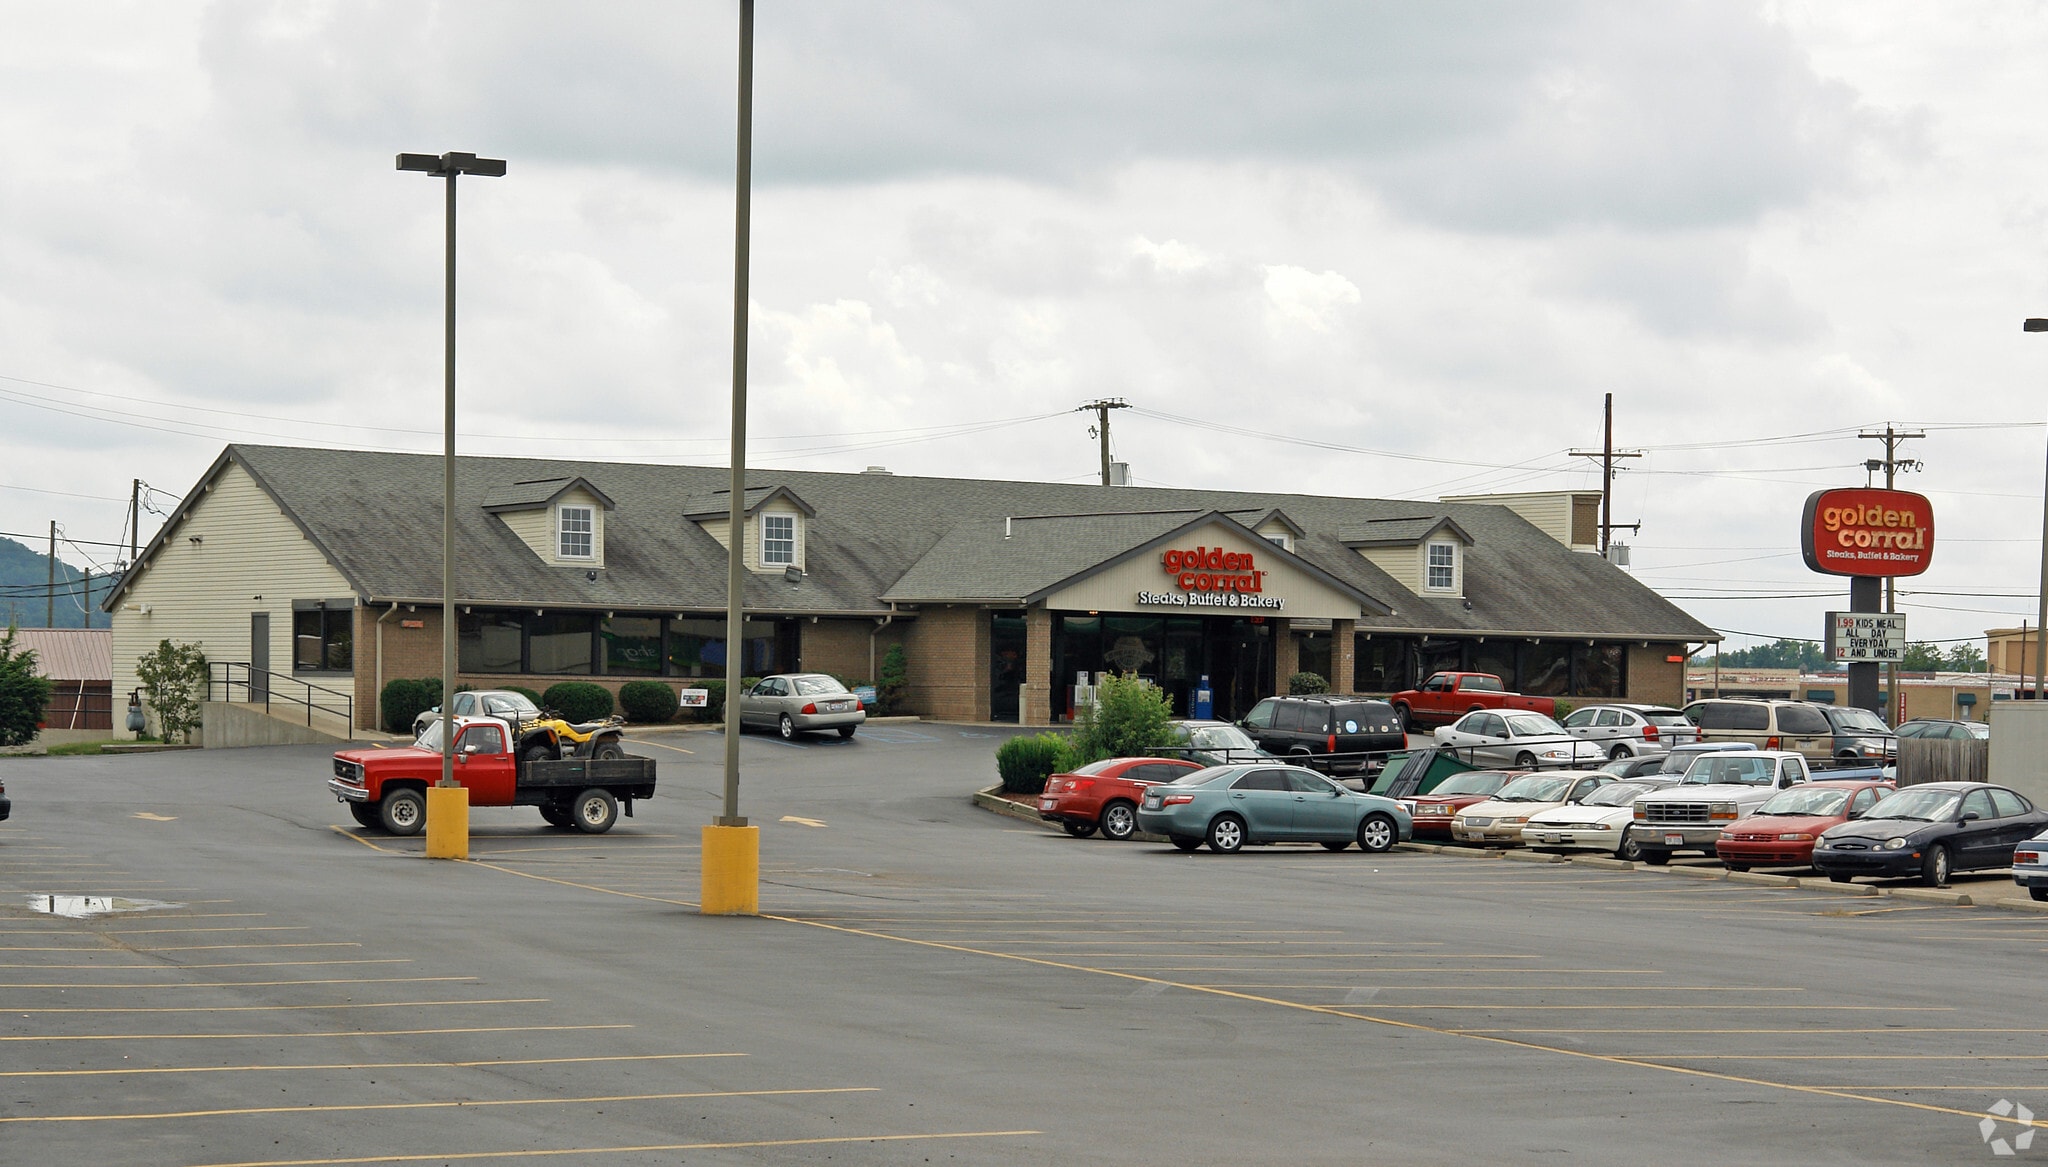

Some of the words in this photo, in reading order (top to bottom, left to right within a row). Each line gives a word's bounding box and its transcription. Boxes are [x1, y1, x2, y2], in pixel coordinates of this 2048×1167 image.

[1823, 504, 1916, 531] golden
[1838, 528, 1924, 550] corral
[1164, 546, 1254, 574] golden
[1858, 551, 1882, 560] Buffet
[1883, 552, 1889, 560] &
[1890, 552, 1919, 562] Bakery
[1178, 570, 1262, 592] corral
[1139, 592, 1188, 607] Steaks,
[1189, 593, 1227, 606] Buffet
[1228, 594, 1239, 607] &
[1240, 594, 1285, 610] Bakery
[1837, 619, 1854, 628] 1.99
[1856, 619, 1873, 628] KIDS
[1876, 619, 1896, 628] MEAL
[1846, 629, 1860, 637] ALL
[1871, 629, 1887, 638] DAY
[1850, 639, 1889, 648] EVERYDAY
[1837, 648, 1845, 657] 12
[1851, 648, 1866, 657] AND
[1874, 649, 1898, 658] UNDER
